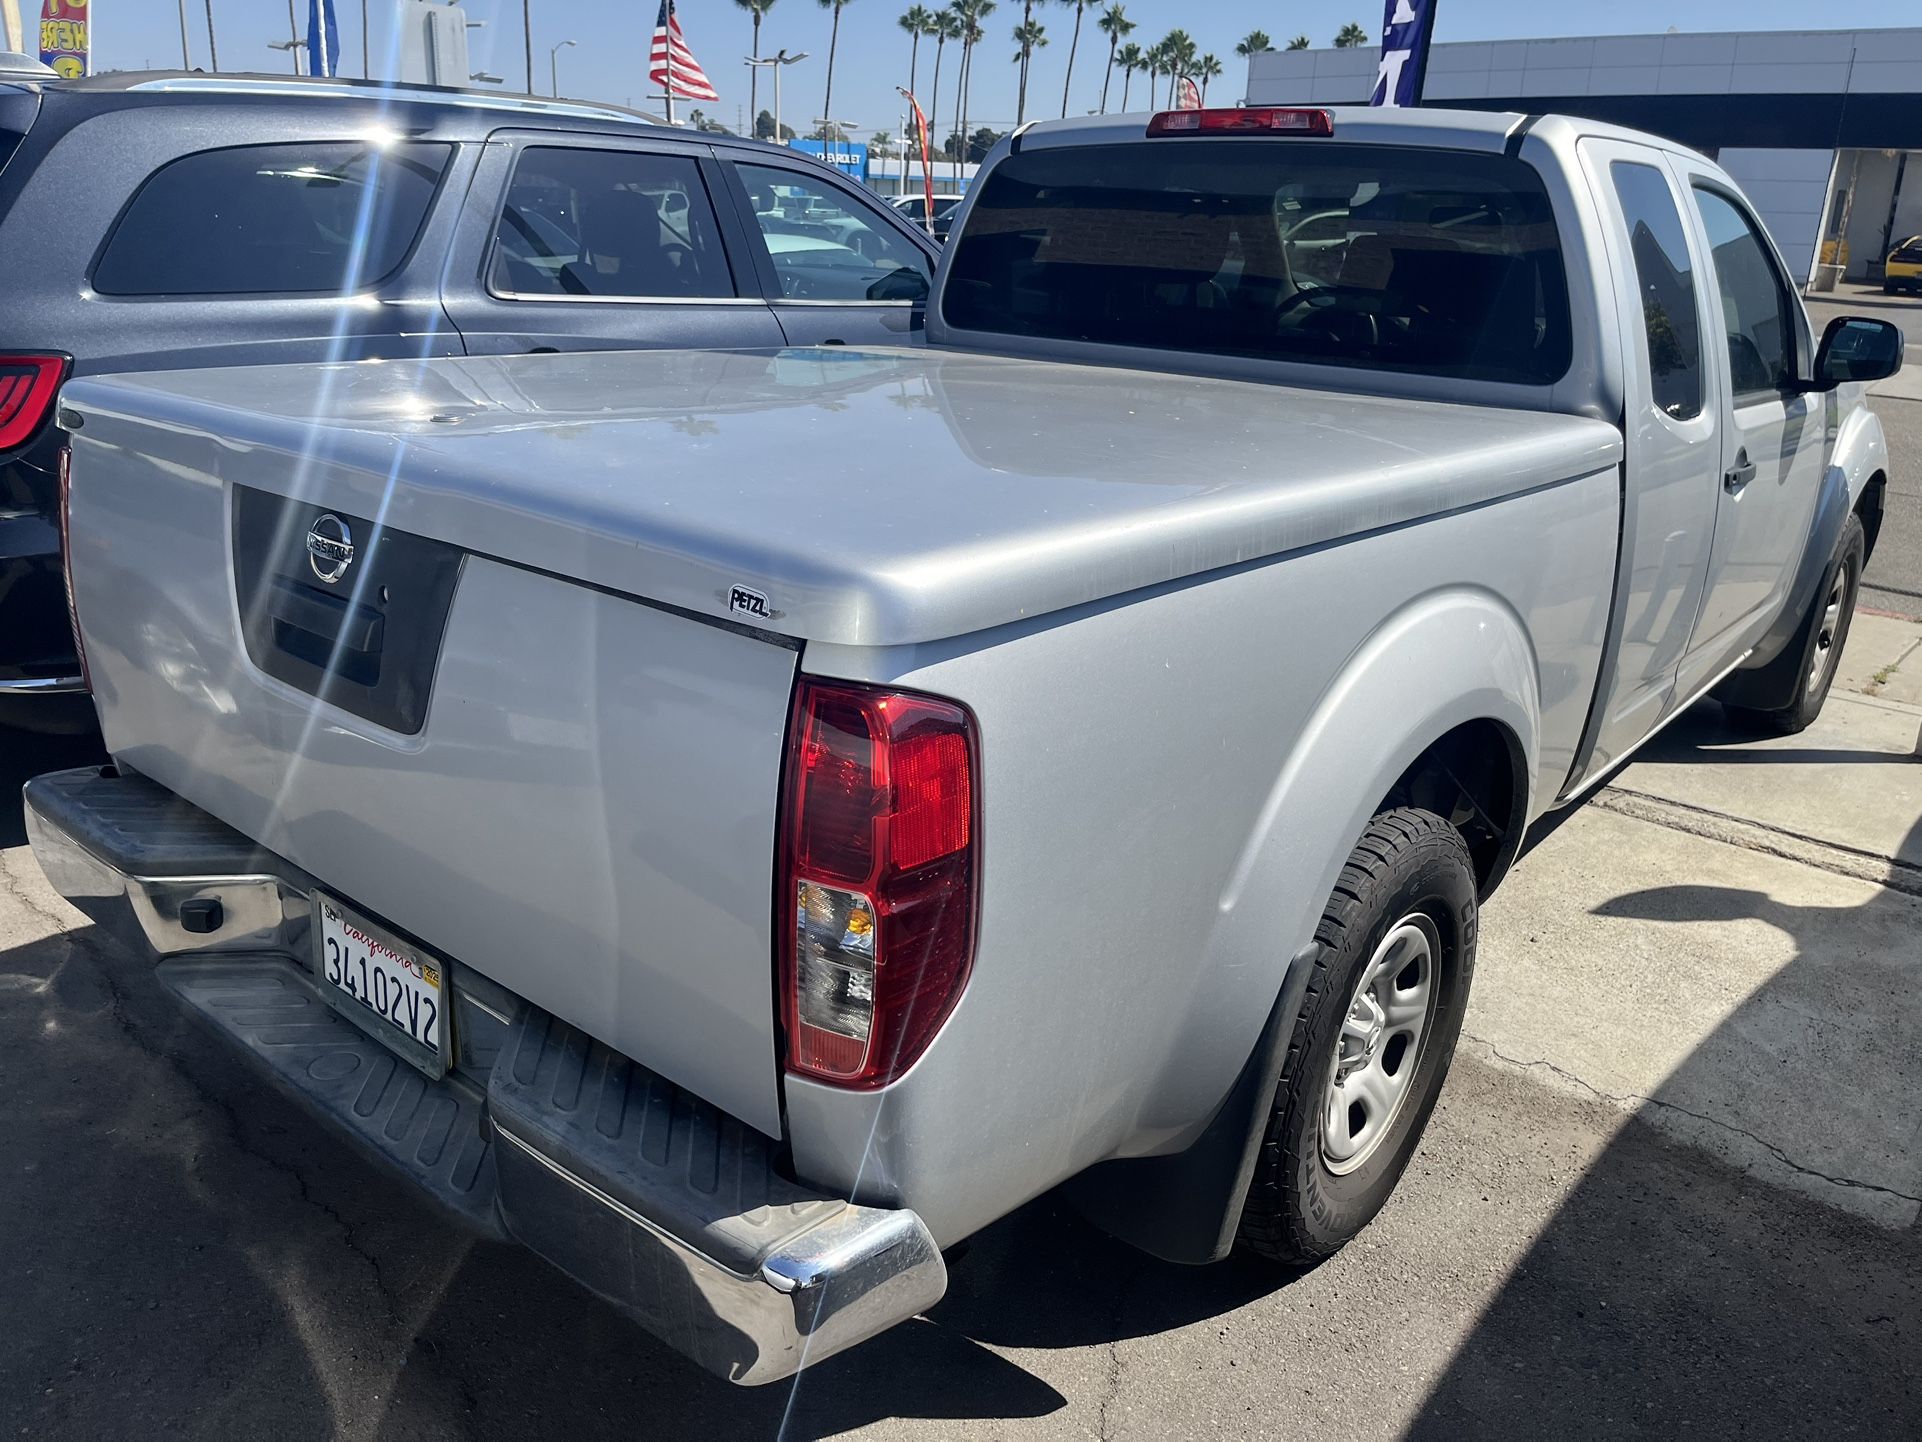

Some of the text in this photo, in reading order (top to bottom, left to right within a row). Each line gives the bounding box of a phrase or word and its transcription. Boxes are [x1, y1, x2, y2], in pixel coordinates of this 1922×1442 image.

[308, 533, 346, 560] NISSAN
[730, 588, 770, 617] PETZL
[327, 936, 438, 1052] 34102V2
